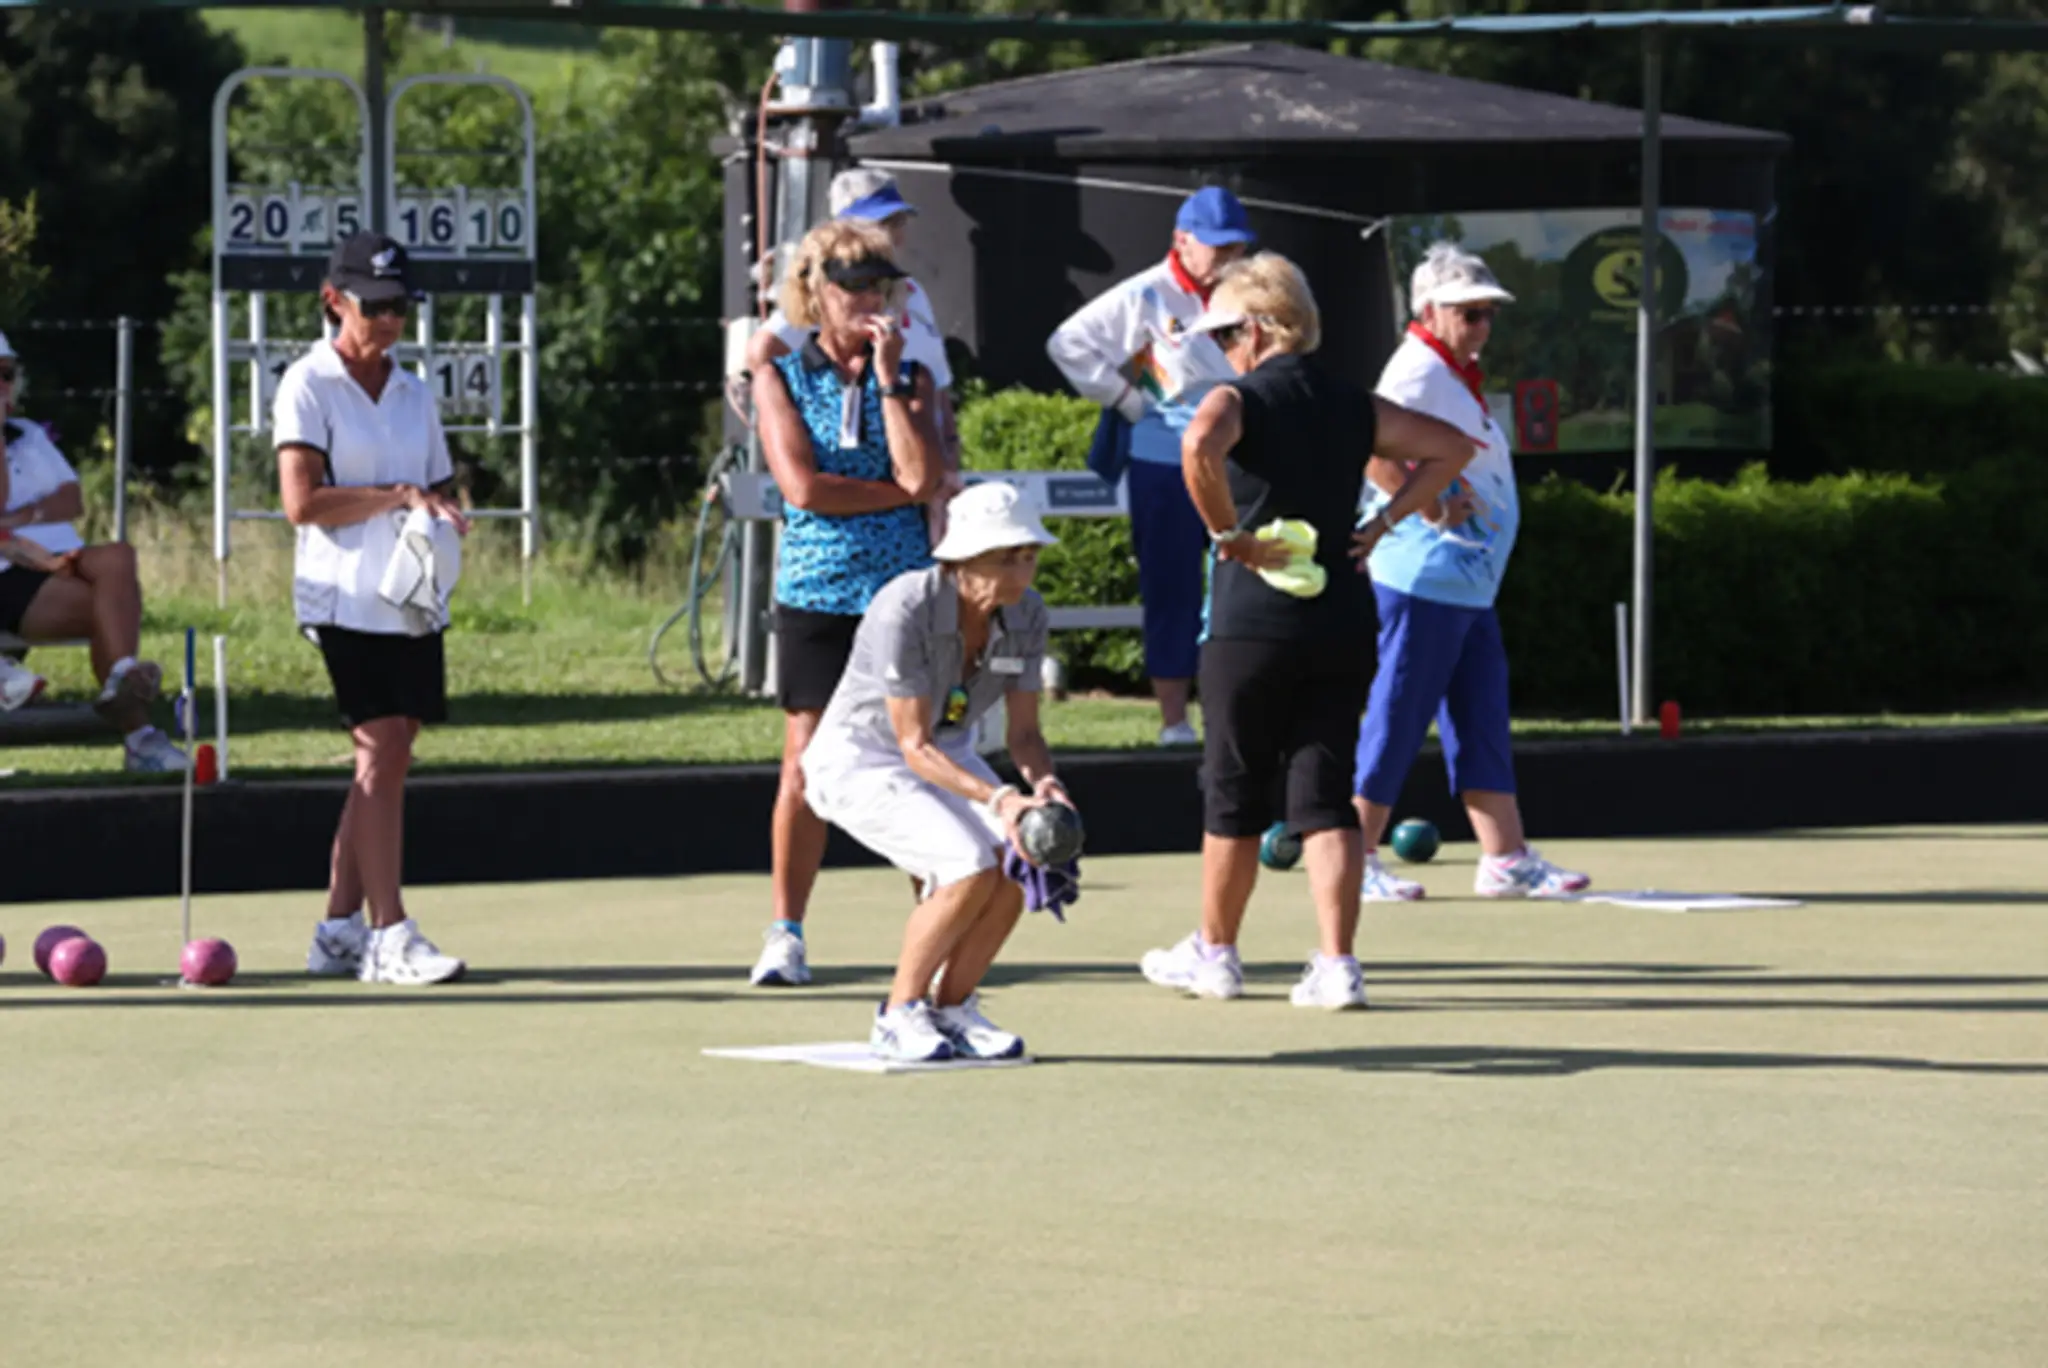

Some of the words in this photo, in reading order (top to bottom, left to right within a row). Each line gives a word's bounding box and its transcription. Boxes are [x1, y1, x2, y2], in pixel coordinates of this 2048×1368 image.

[230, 201, 288, 239] 20
[336, 204, 359, 239] 5
[400, 204, 453, 243] 16
[471, 204, 521, 243] 10
[436, 360, 489, 398] 14
[1522, 386, 1554, 445] 8
